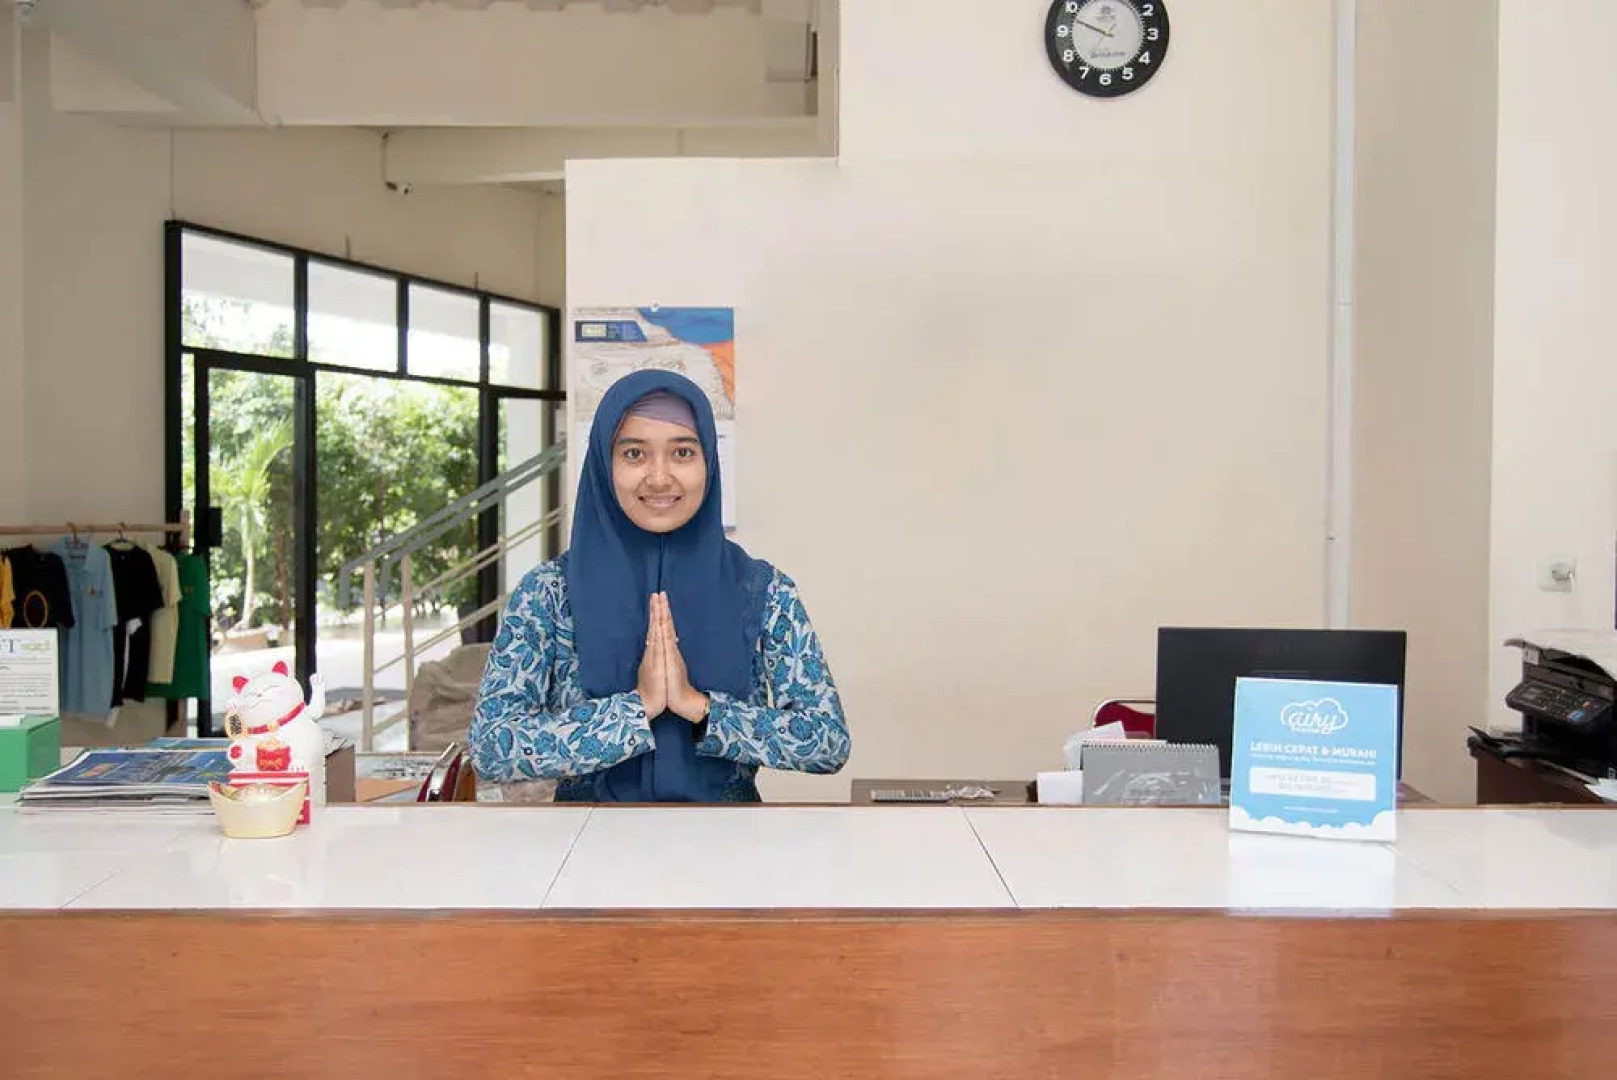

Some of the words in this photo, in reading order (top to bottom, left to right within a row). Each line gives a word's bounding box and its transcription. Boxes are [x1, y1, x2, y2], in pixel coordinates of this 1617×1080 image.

[1065, 1, 1078, 14] 10
[1143, 4, 1154, 17] 2
[1056, 25, 1068, 38] 9
[1147, 28, 1159, 41] 3
[1063, 49, 1074, 62] 8
[1138, 51, 1151, 65] 4
[1079, 66, 1090, 80] 7
[1099, 73, 1112, 86] 6
[1121, 67, 1134, 80] 5
[1284, 743, 1319, 755] CEPAT
